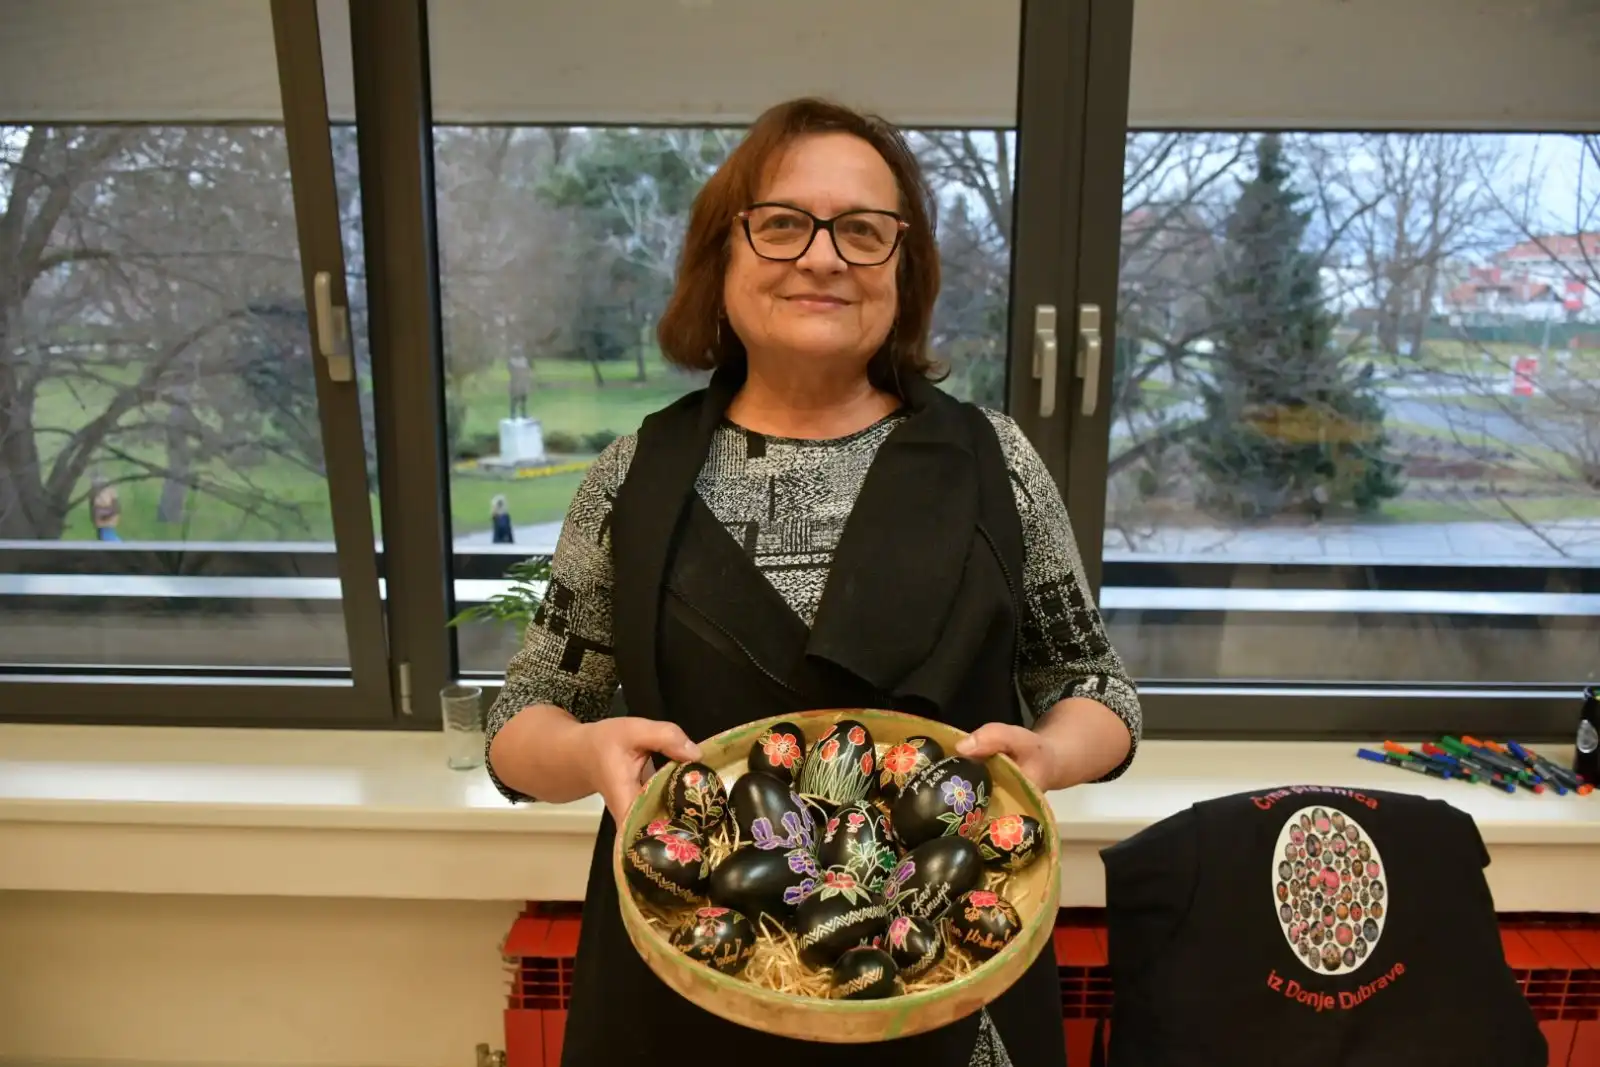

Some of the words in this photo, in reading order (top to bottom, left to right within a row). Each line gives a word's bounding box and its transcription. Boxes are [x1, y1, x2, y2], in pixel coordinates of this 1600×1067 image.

[1267, 969, 1284, 992] iz
[1285, 979, 1335, 1012] Donje
[1338, 962, 1405, 1009] Dubrave
